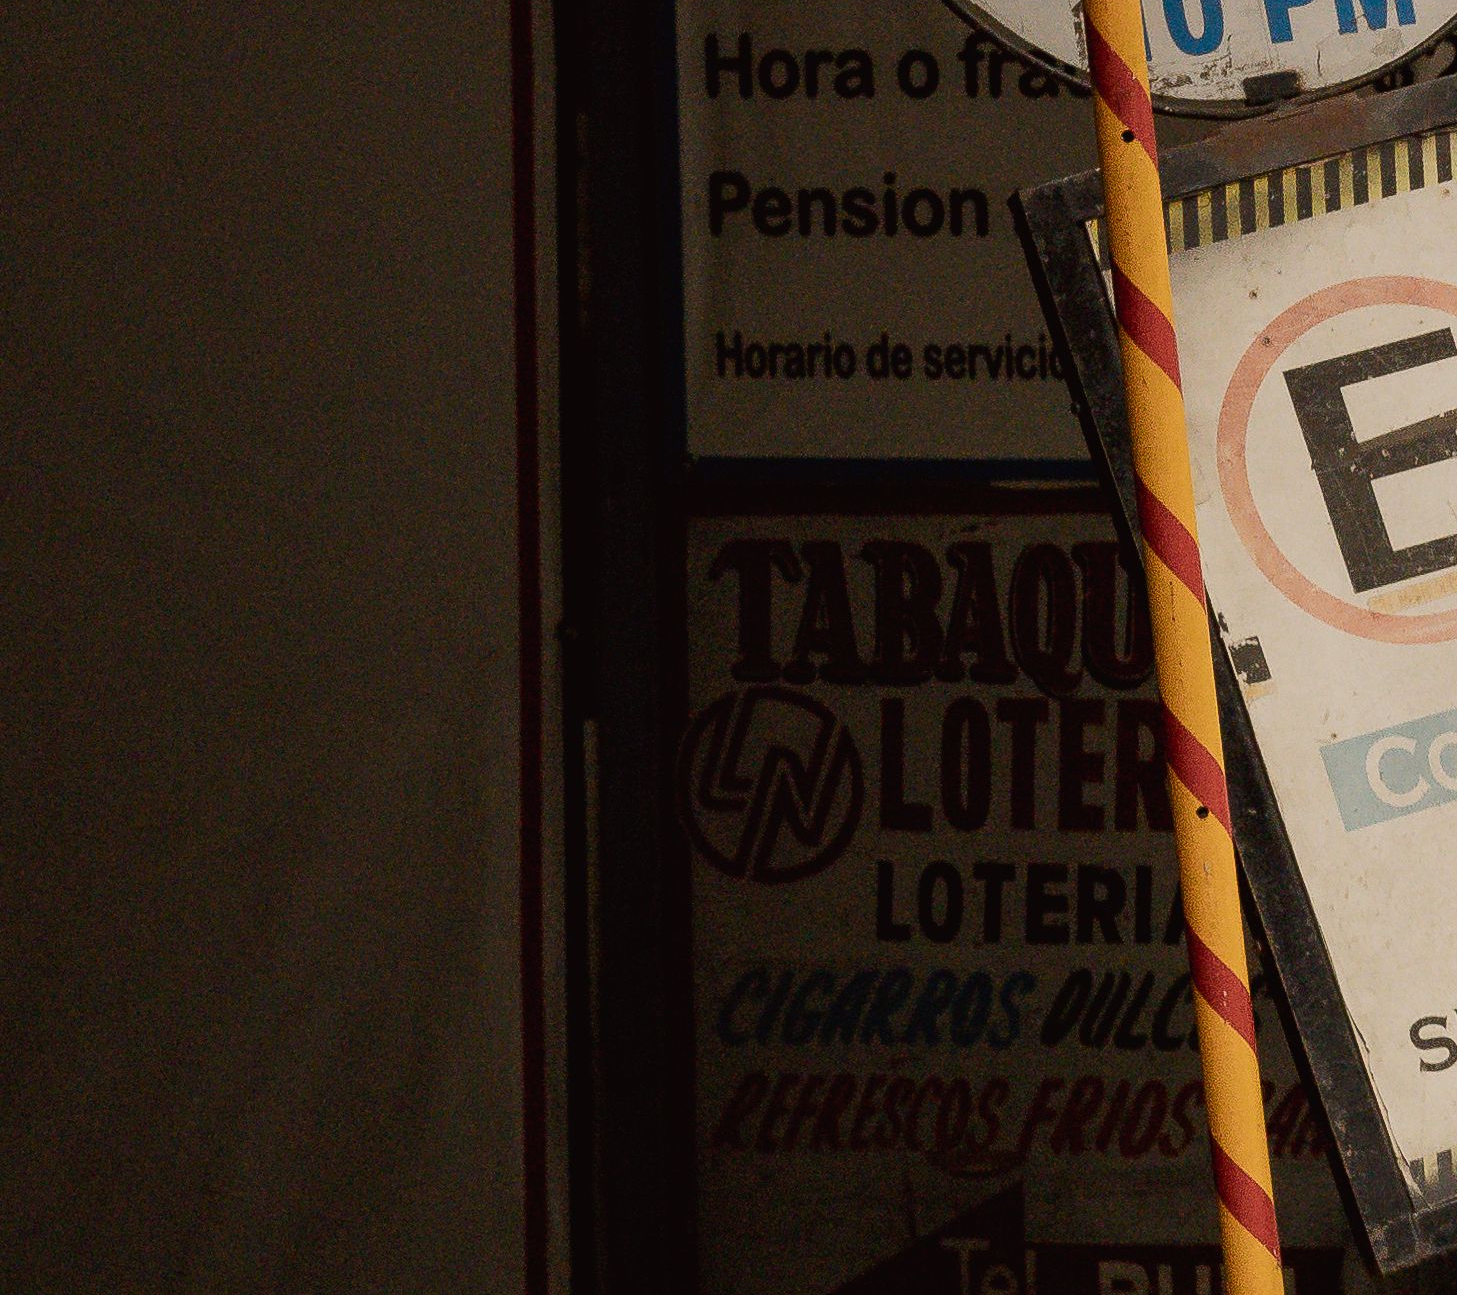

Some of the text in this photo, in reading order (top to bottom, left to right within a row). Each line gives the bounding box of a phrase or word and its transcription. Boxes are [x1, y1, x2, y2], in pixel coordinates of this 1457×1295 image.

[703, 30, 877, 100] Hora
[898, 47, 941, 100] o
[709, 171, 989, 237] Pension
[714, 331, 856, 380] Horario
[865, 332, 913, 380] de
[923, 333, 1070, 381] servicio
[715, 966, 1037, 1052] CIGARROS
